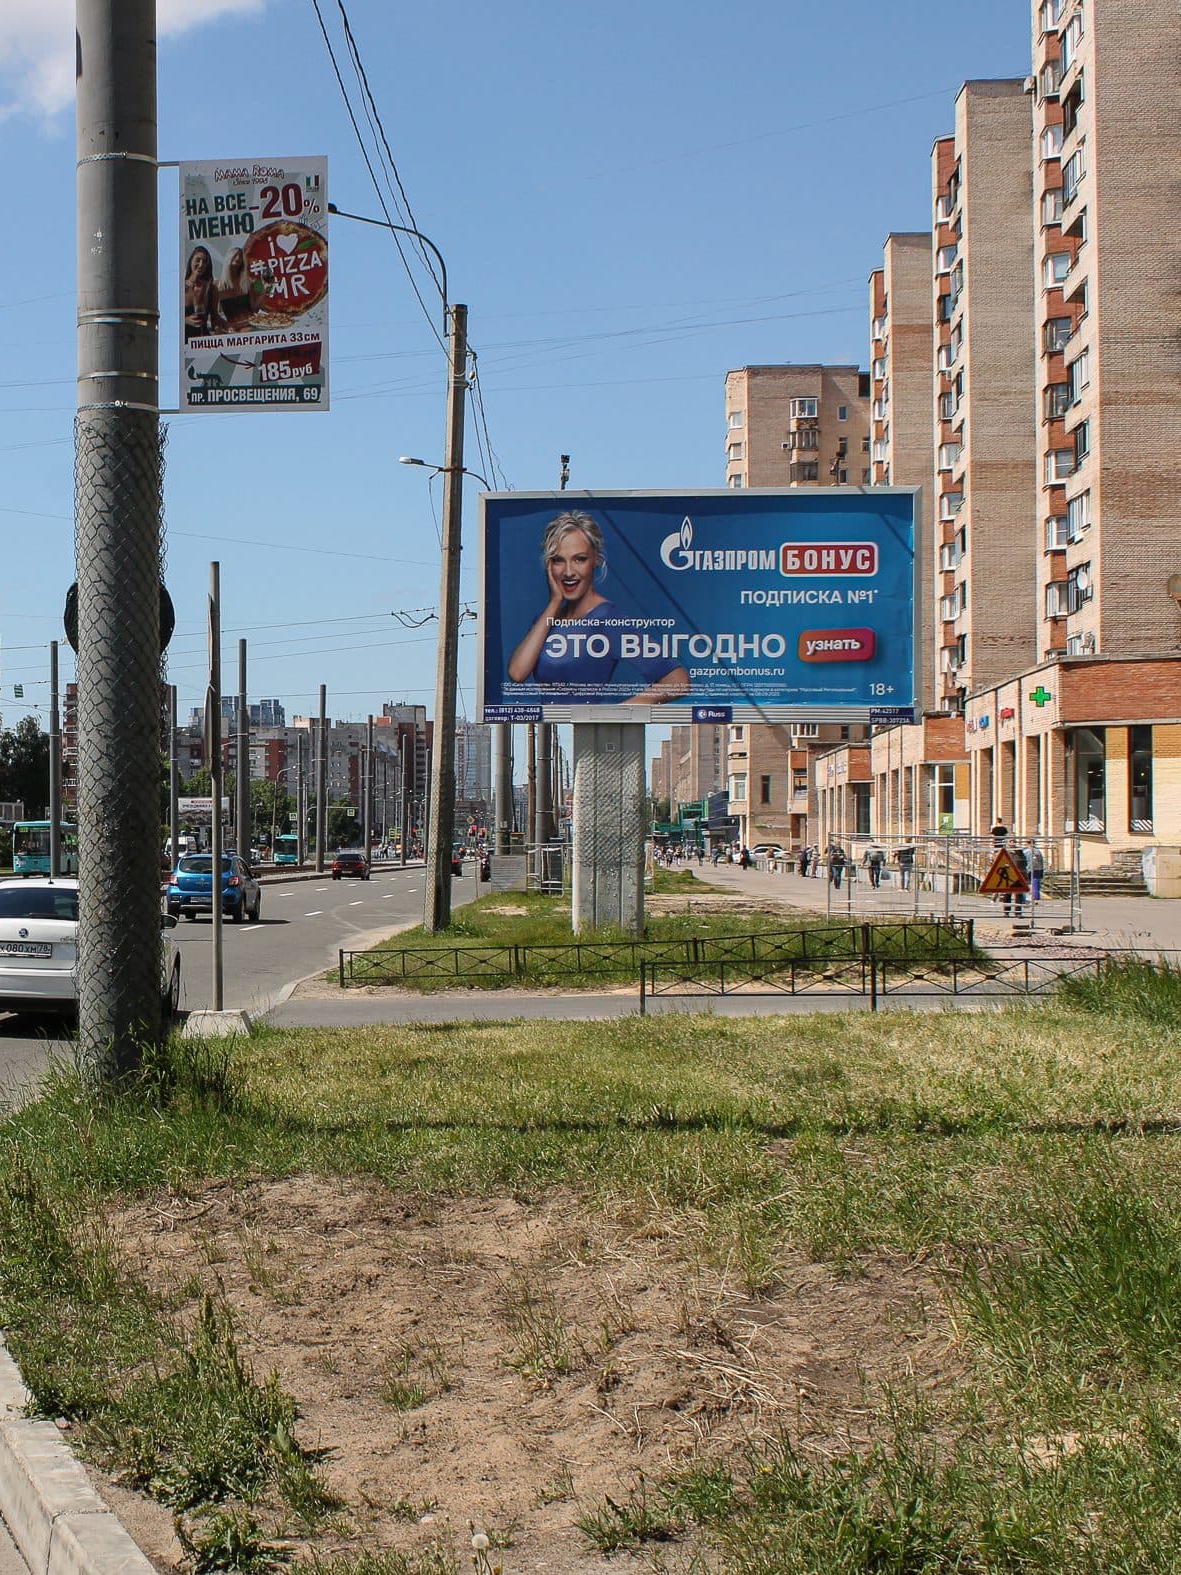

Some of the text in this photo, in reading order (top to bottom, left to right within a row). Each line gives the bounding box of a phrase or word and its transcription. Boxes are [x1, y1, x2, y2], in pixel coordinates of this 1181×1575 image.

[186, 192, 247, 216] НА ВСЕ
[188, 212, 255, 240] МЕНЮ
[269, 274, 310, 299] MR
[190, 339, 224, 350] ПИЦЦА
[227, 334, 287, 347] МАРГАРИТА
[207, 388, 300, 402] ПРОСВЕЩЕНИЯ,
[303, 388, 318, 399] 69
[786, 549, 871, 570] БОНУС
[740, 590, 843, 607] ПОДПИСКА
[546, 617, 675, 627] Подписка-конструктор
[546, 634, 786, 663] ЭТО ВЫГОДНО
[806, 639, 861, 656] узнать
[690, 667, 785, 679] gazprombonus.ru
[869, 683, 895, 696] 18+
[708, 710, 726, 718] Russ
